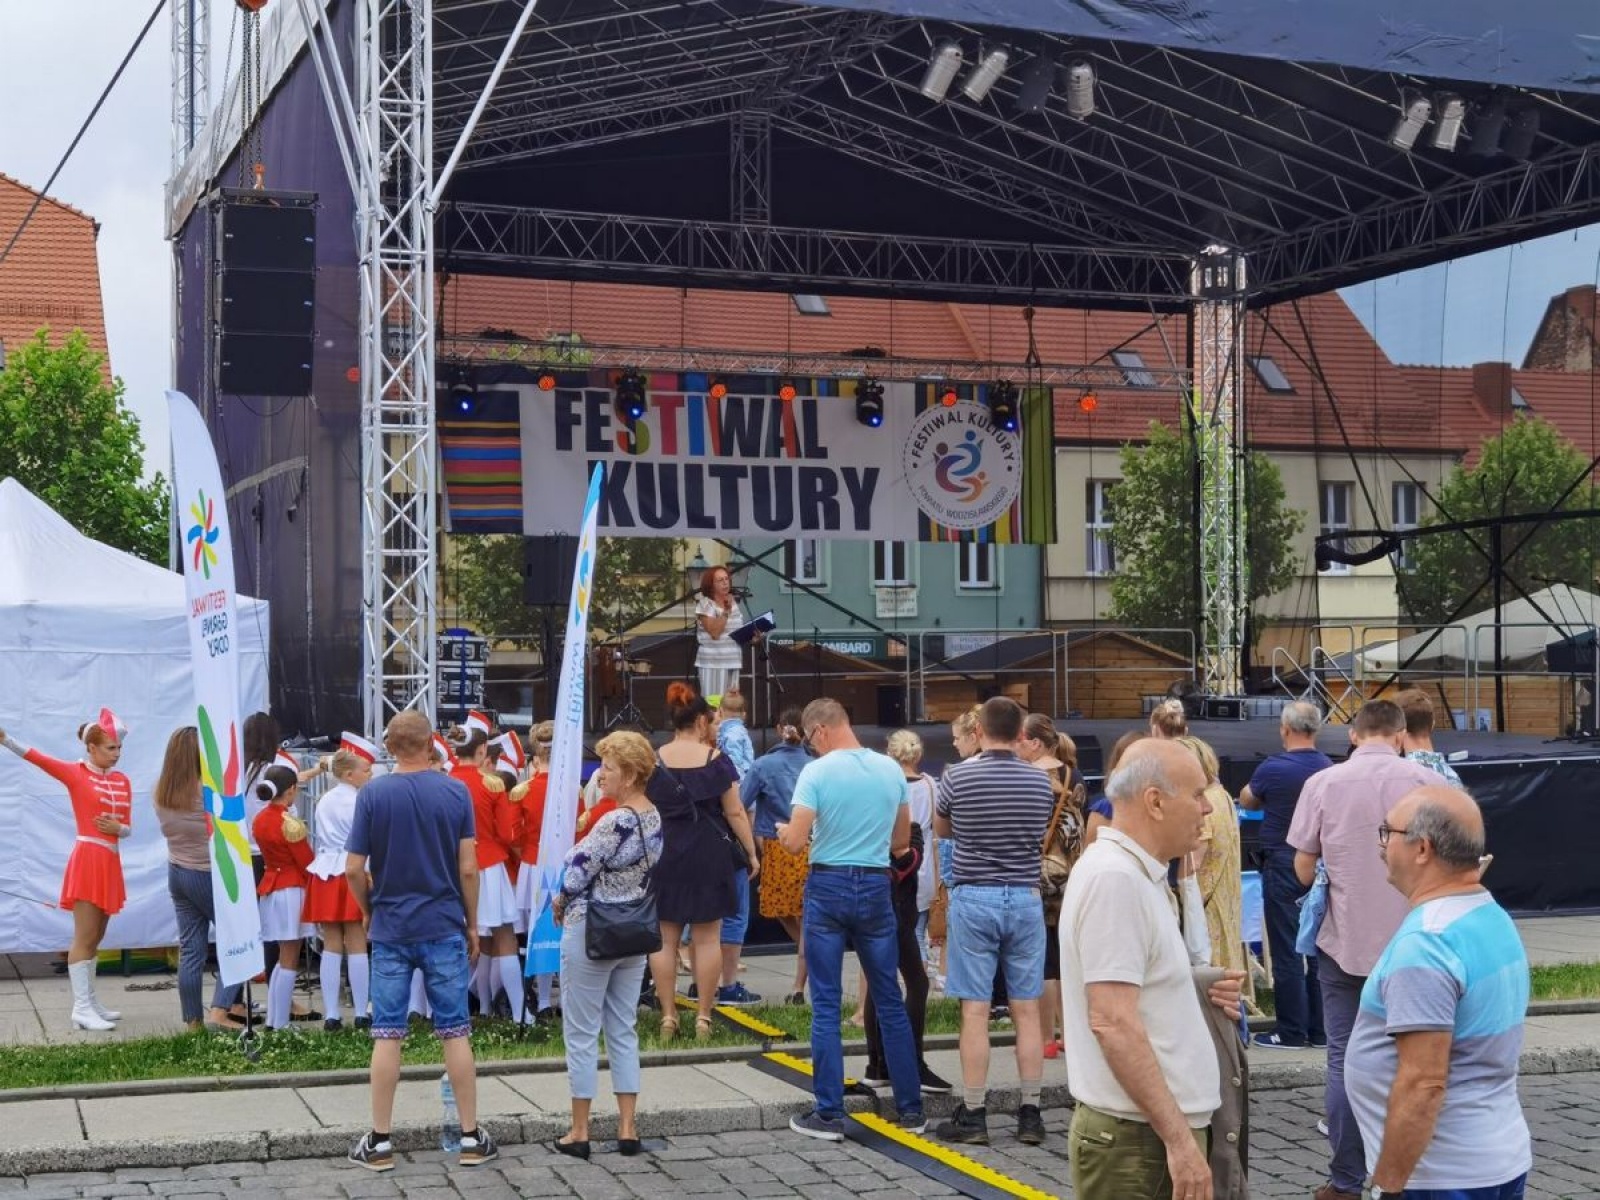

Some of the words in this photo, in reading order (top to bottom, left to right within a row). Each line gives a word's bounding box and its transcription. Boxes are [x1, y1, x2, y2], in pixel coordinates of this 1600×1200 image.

[554, 388, 829, 459] FESTIWAL
[911, 411, 964, 459] FESTIWAL
[587, 460, 881, 532] KULTURY
[818, 641, 871, 653] OMBARD
